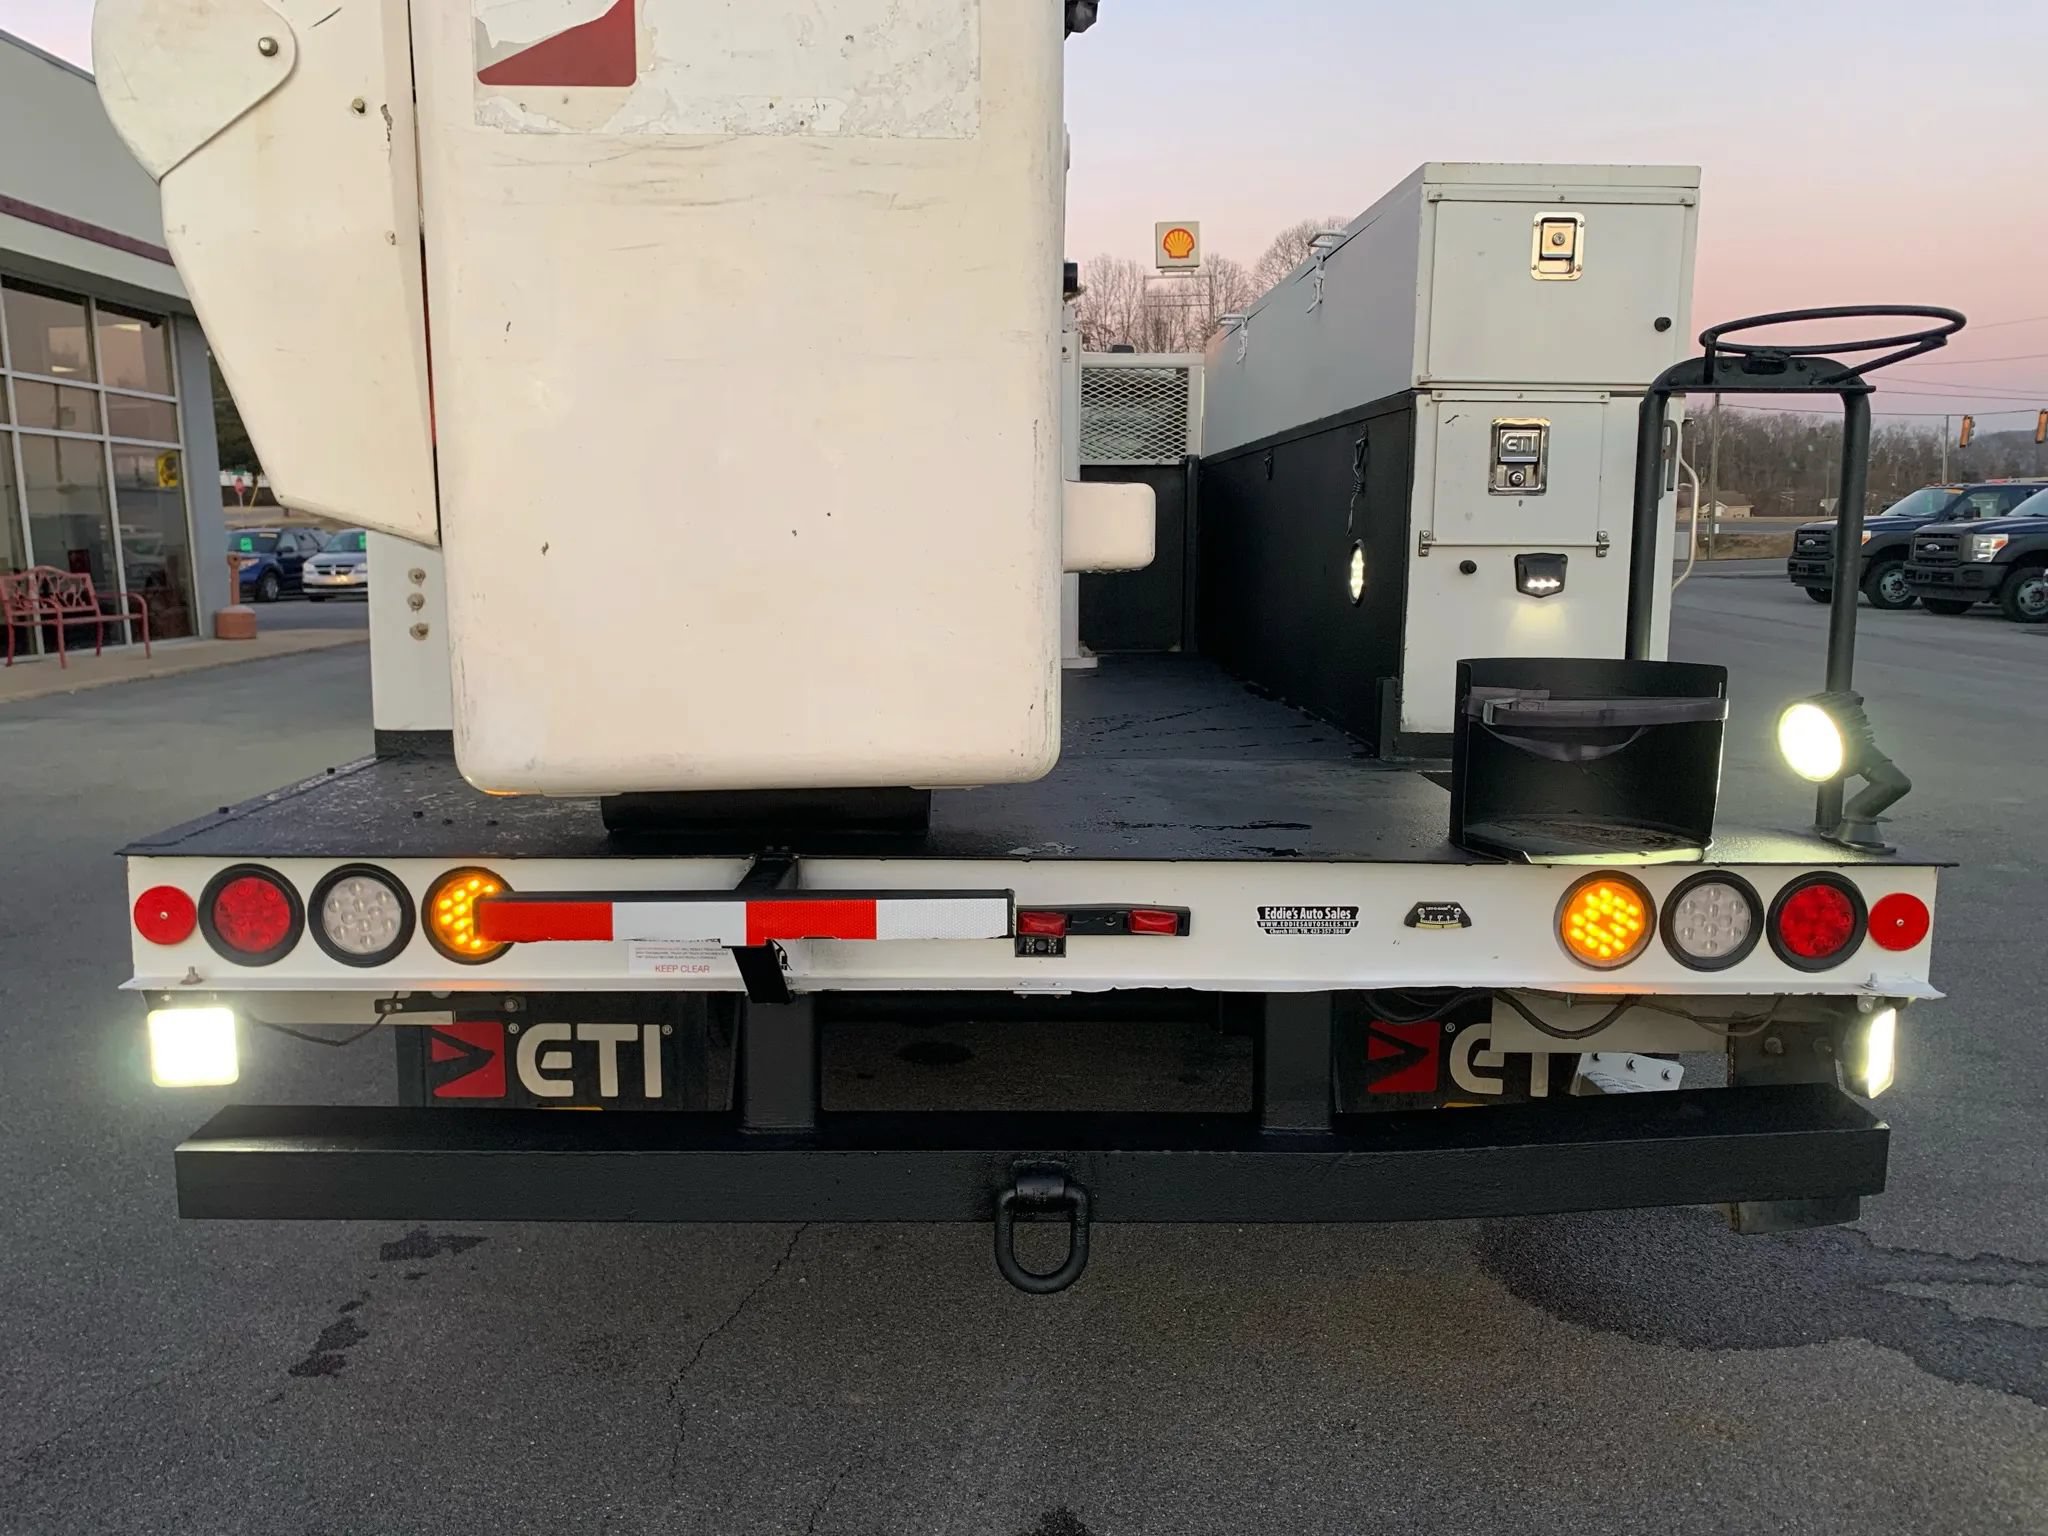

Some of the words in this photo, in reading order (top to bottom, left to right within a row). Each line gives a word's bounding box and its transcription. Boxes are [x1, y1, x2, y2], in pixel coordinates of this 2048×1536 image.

[1264, 907, 1298, 920] Eddie's
[1300, 907, 1323, 920] Auto
[1325, 907, 1351, 920] Sales
[655, 964, 679, 973] KEEP
[680, 964, 710, 973] CLEAR
